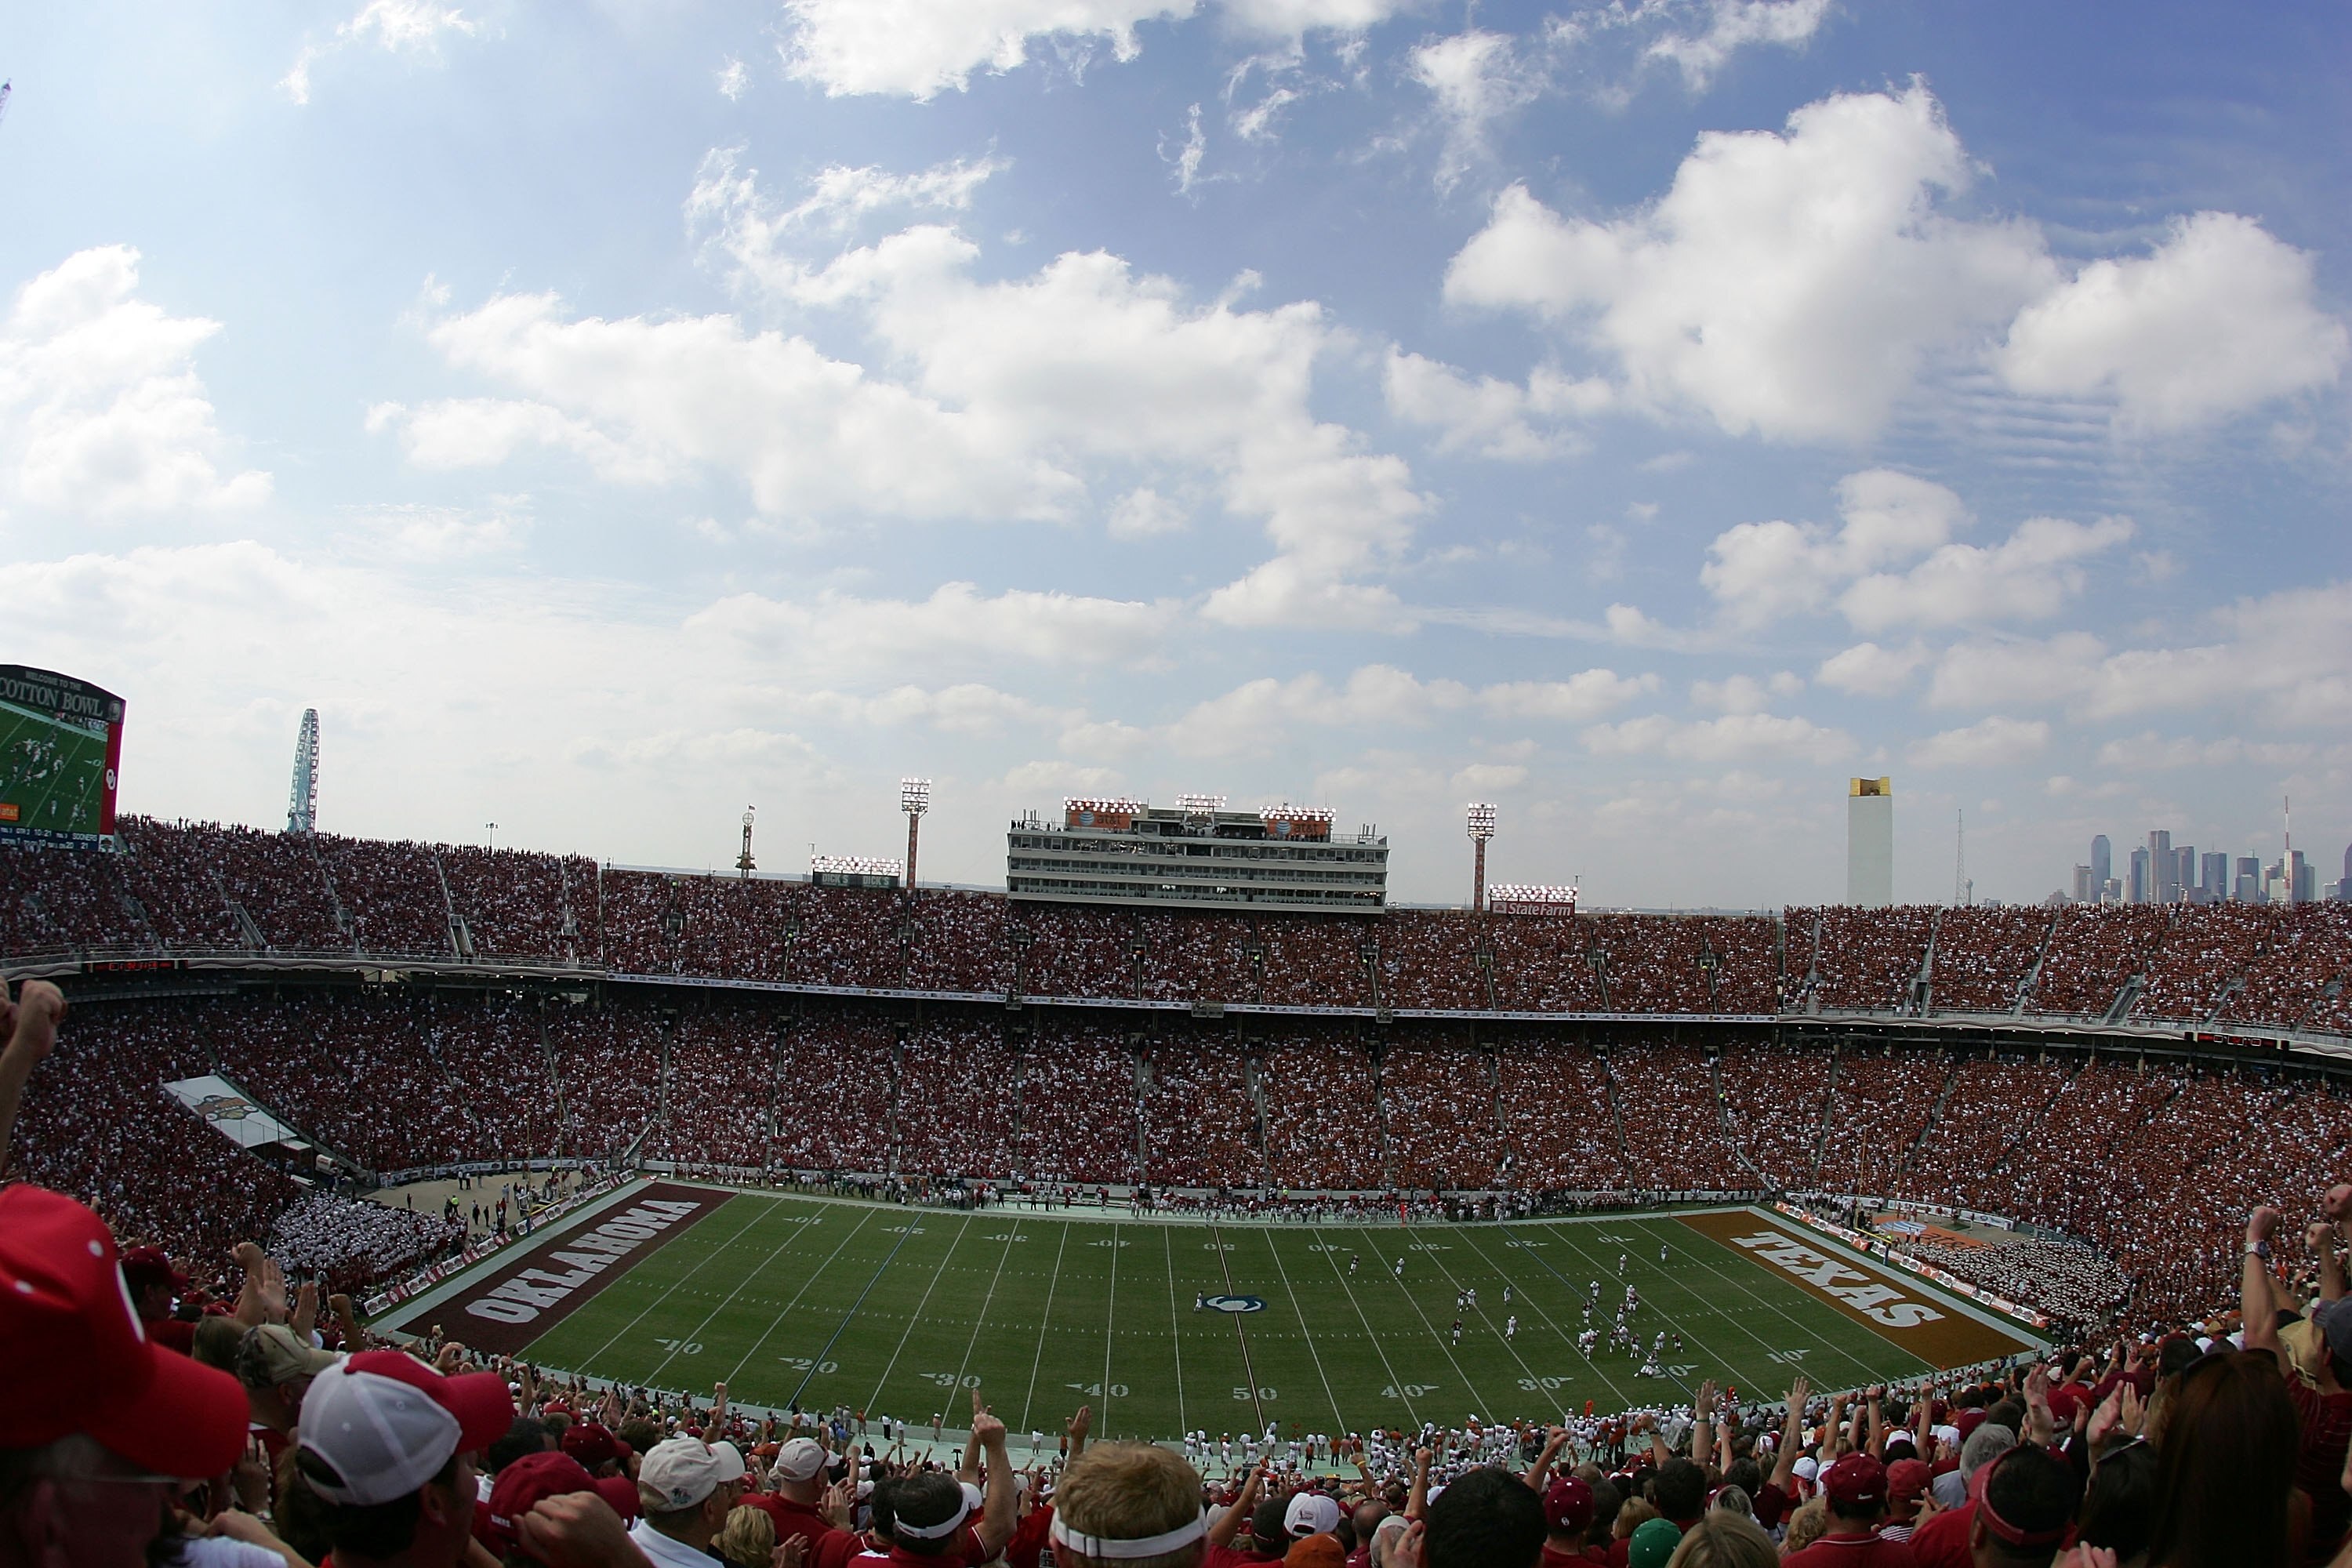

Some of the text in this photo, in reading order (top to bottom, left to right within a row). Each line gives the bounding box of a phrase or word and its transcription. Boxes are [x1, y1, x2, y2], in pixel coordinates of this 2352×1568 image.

[25, 670, 82, 691] WELCOME TO THE
[62, 691, 103, 717] BOWL
[1098, 815, 1122, 825] at&t
[1294, 822, 1320, 834] at&t
[72, 833, 98, 842] SOONERS
[1508, 902, 1570, 916] State Farm
[465, 1200, 702, 1323] OKLAHOMA
[1730, 1231, 1945, 1327] TEXAS
[664, 1339, 704, 1356] 10
[1766, 1349, 1803, 1363] 10
[791, 1358, 839, 1374] 20
[935, 1373, 982, 1388] 30
[1517, 1377, 1561, 1392] 30
[1083, 1383, 1129, 1398] 40
[1232, 1387, 1278, 1401] 50
[1381, 1385, 1425, 1399] 40
